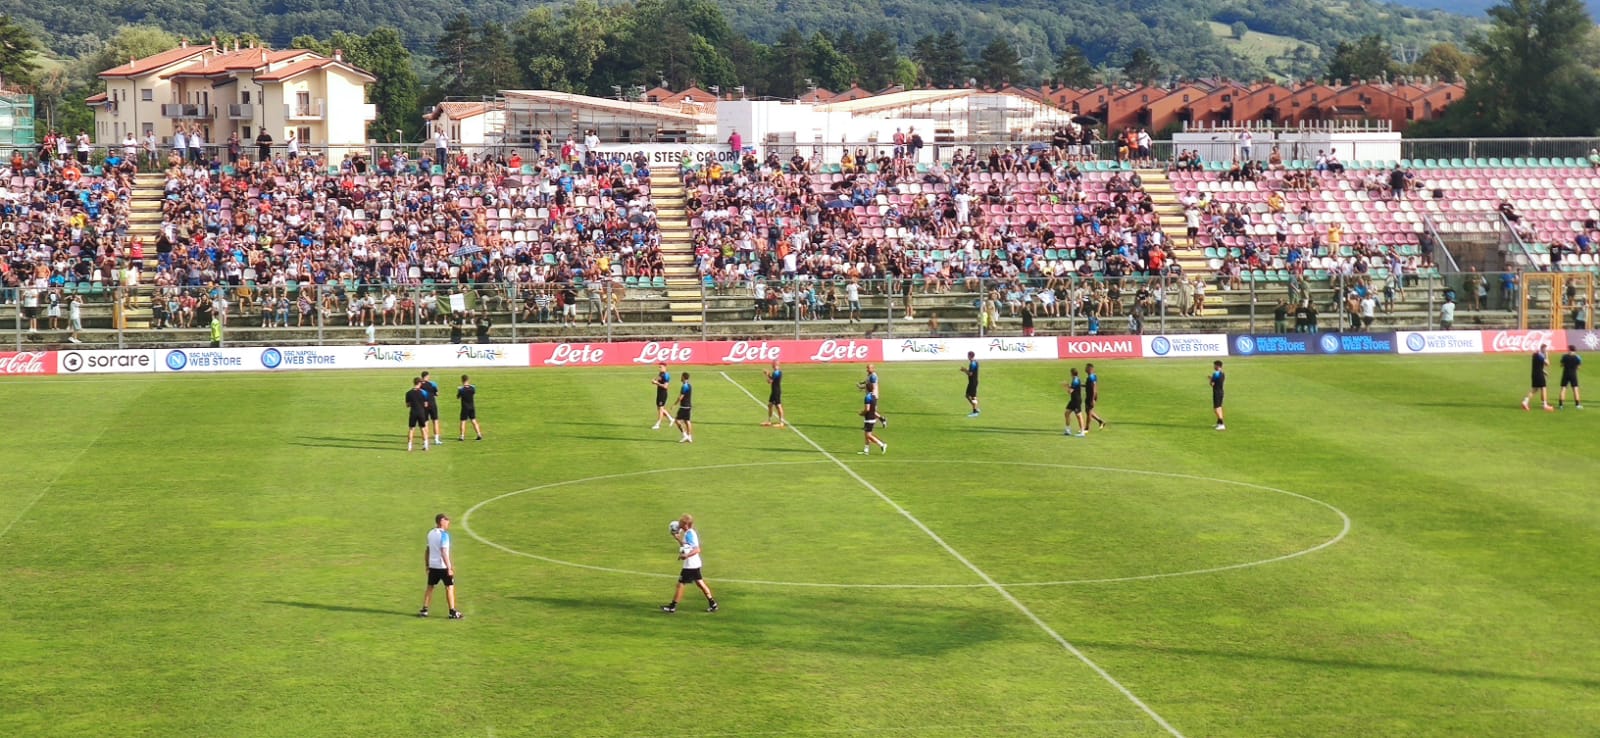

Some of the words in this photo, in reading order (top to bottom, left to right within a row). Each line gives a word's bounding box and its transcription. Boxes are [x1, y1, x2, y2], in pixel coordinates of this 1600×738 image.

[619, 151, 650, 162] DAGI
[654, 151, 692, 162] STES
[1068, 341, 1133, 354] KONAMI
[1172, 343, 1191, 352] WEB
[1193, 343, 1220, 351] STORE
[1257, 342, 1277, 352] WEB
[1278, 341, 1305, 351] STORE
[1342, 341, 1362, 350] WEB
[1363, 340, 1390, 350] STORE
[1427, 340, 1446, 348] WEB
[1448, 339, 1474, 348] STORE
[544, 343, 604, 365] Lete
[633, 341, 692, 363] Lete
[722, 340, 781, 362] Lete
[810, 339, 869, 361] Lete
[88, 354, 150, 367] sorare
[189, 357, 210, 366] WEB
[212, 357, 242, 365] STORE
[284, 356, 304, 364] WEB
[307, 355, 336, 364] STORE
